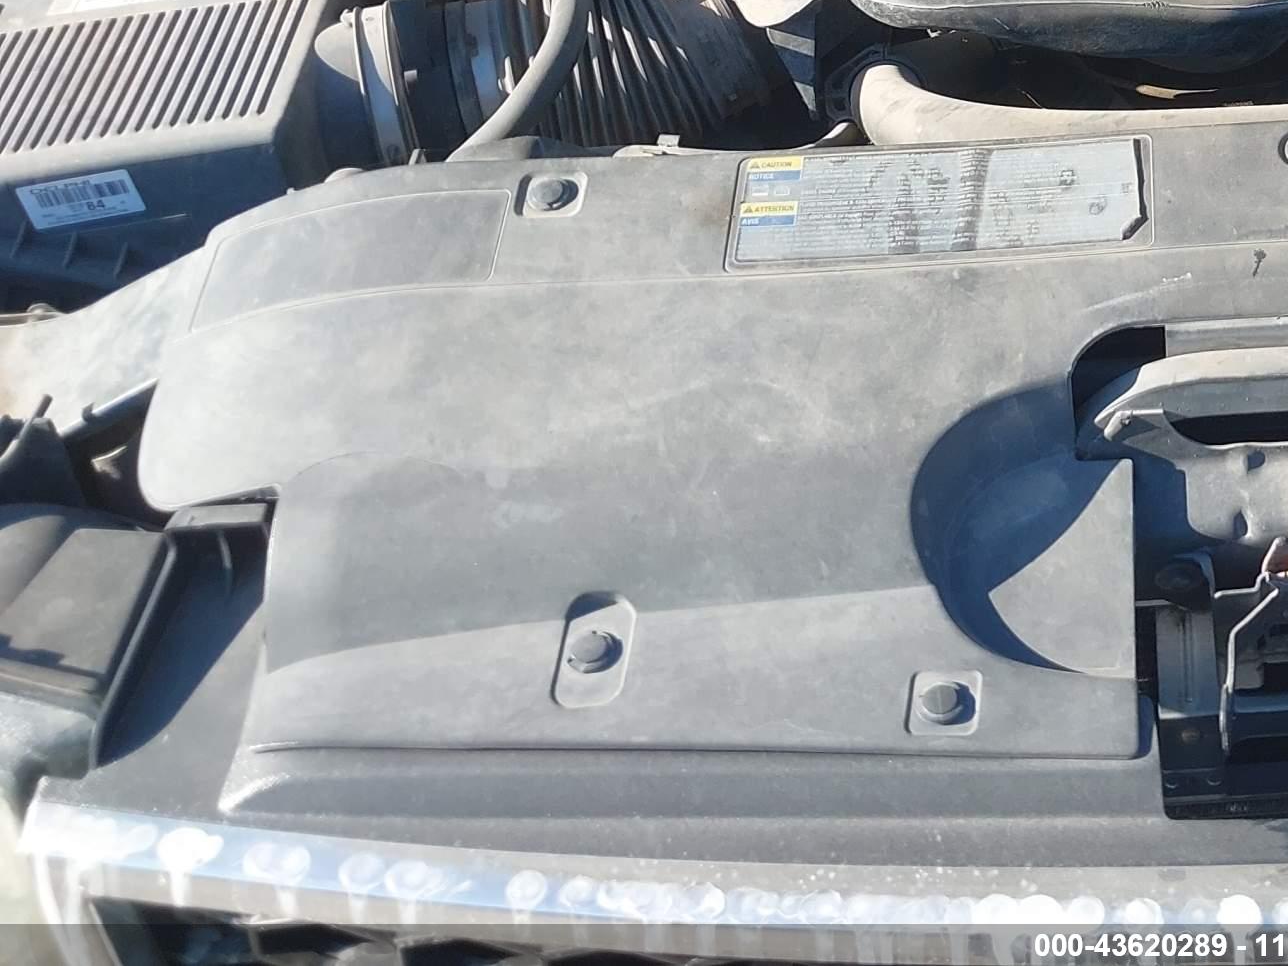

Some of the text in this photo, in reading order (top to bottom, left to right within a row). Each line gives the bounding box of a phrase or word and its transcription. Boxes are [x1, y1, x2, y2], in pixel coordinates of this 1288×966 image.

[761, 161, 793, 169] CAUTION
[748, 172, 775, 180] NOTICE
[754, 205, 795, 214] ATTENTION
